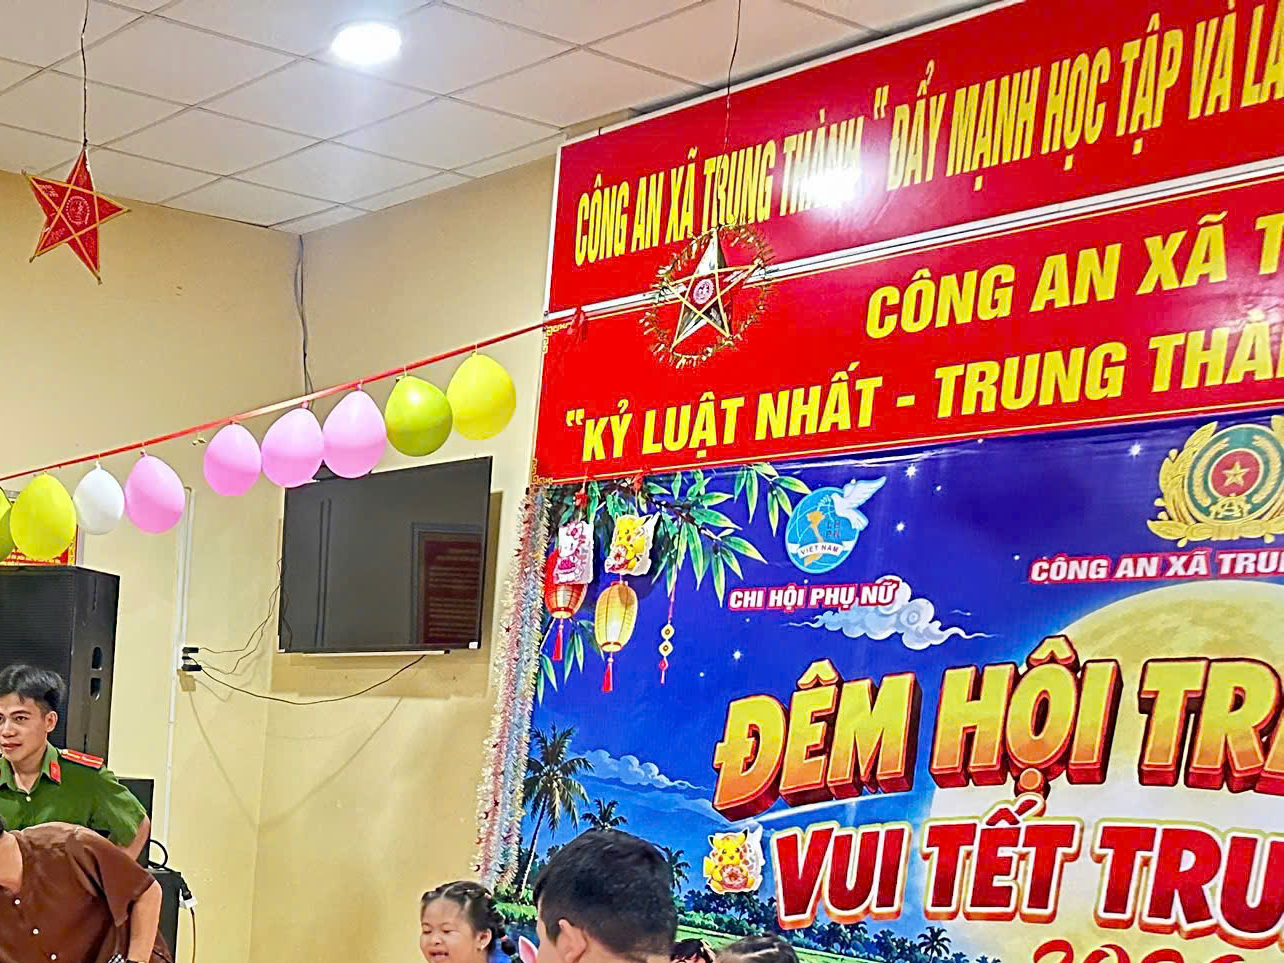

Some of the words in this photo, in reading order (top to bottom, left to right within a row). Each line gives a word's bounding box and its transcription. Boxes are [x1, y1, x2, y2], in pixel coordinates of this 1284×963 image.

[575, 173, 629, 265] CÔNG
[631, 171, 664, 253] AN
[665, 146, 699, 244] XÃ
[702, 139, 777, 227] TRUNG
[945, 65, 1041, 191] MẠNH
[1043, 46, 1111, 168] HỌC
[1116, 12, 1184, 155] TẬP
[866, 260, 1013, 339] CÔNG
[1028, 242, 1122, 308] AN
[1136, 211, 1228, 295] XÃ
[642, 391, 740, 454] LUẬT
[758, 361, 883, 440] NHẤT
[936, 341, 1128, 418] TRUNG
[1149, 309, 1284, 393] THÀ
[730, 590, 764, 608] CHI
[769, 586, 805, 610] HỘI
[809, 587, 855, 609] PHỤ
[861, 581, 899, 605] NỮ
[1031, 555, 1109, 581] CÔNG
[1114, 557, 1158, 578] AN
[1160, 551, 1208, 576] XÃ
[713, 659, 918, 820] ĐÊM
[931, 636, 1123, 816] HỘI
[771, 822, 912, 930] VUI
[924, 794, 1080, 922] TẾT
